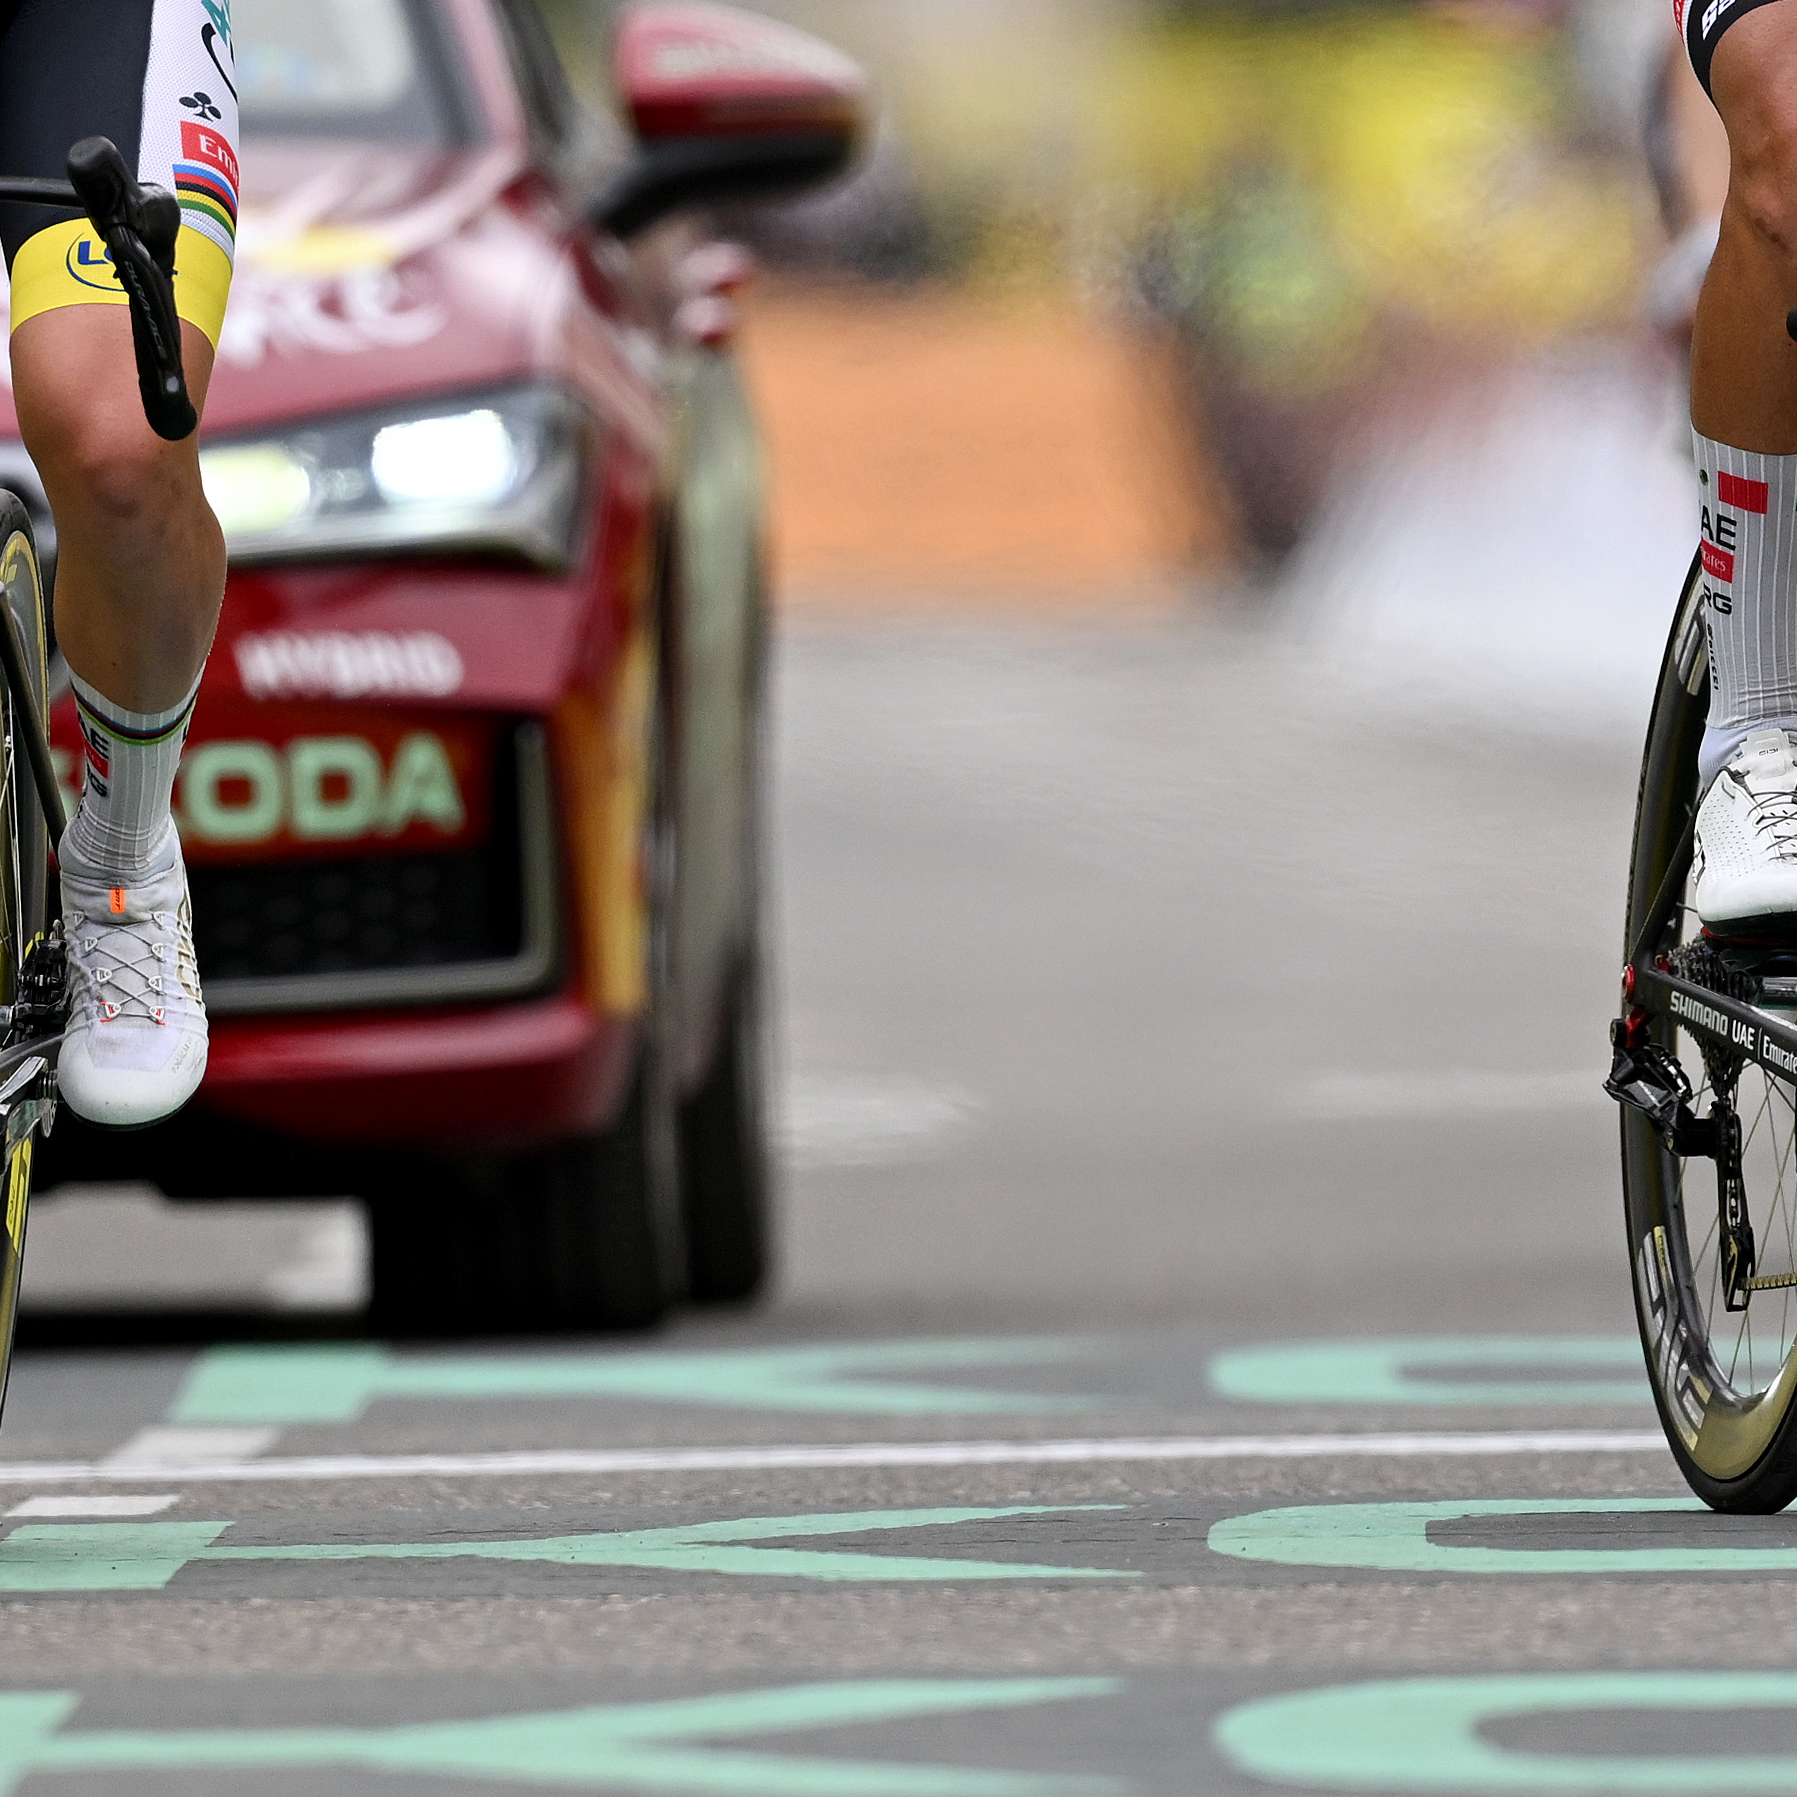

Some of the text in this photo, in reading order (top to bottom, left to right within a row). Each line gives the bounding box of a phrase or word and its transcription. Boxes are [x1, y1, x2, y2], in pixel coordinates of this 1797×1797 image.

[1700, 505, 1738, 552] AE
[235, 630, 466, 703] HYBRID
[1669, 990, 1729, 1037] SHIMANO
[1731, 1019, 1756, 1051] UAE
